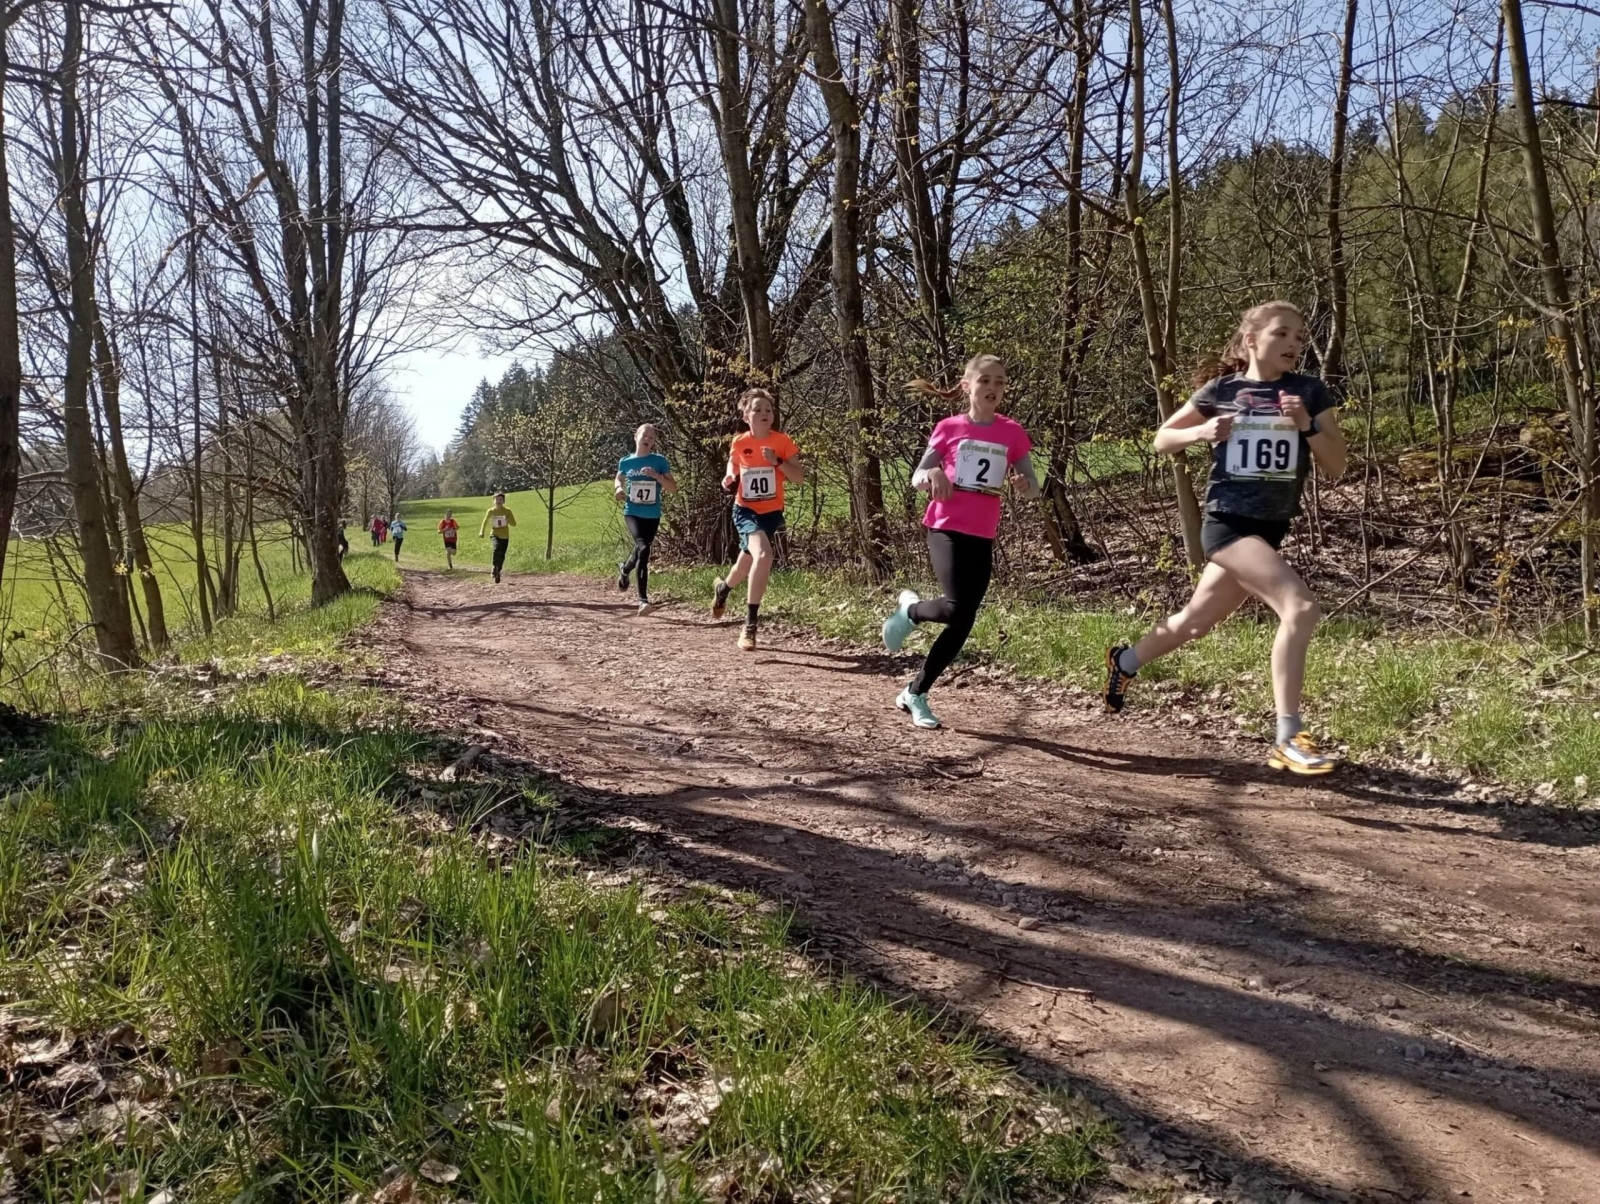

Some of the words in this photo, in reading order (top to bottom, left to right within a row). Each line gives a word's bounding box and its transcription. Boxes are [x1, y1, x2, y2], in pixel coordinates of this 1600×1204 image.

[1237, 438, 1290, 470] 169
[976, 458, 990, 483] 2
[637, 489, 650, 500] 47
[750, 477, 769, 494] 40
